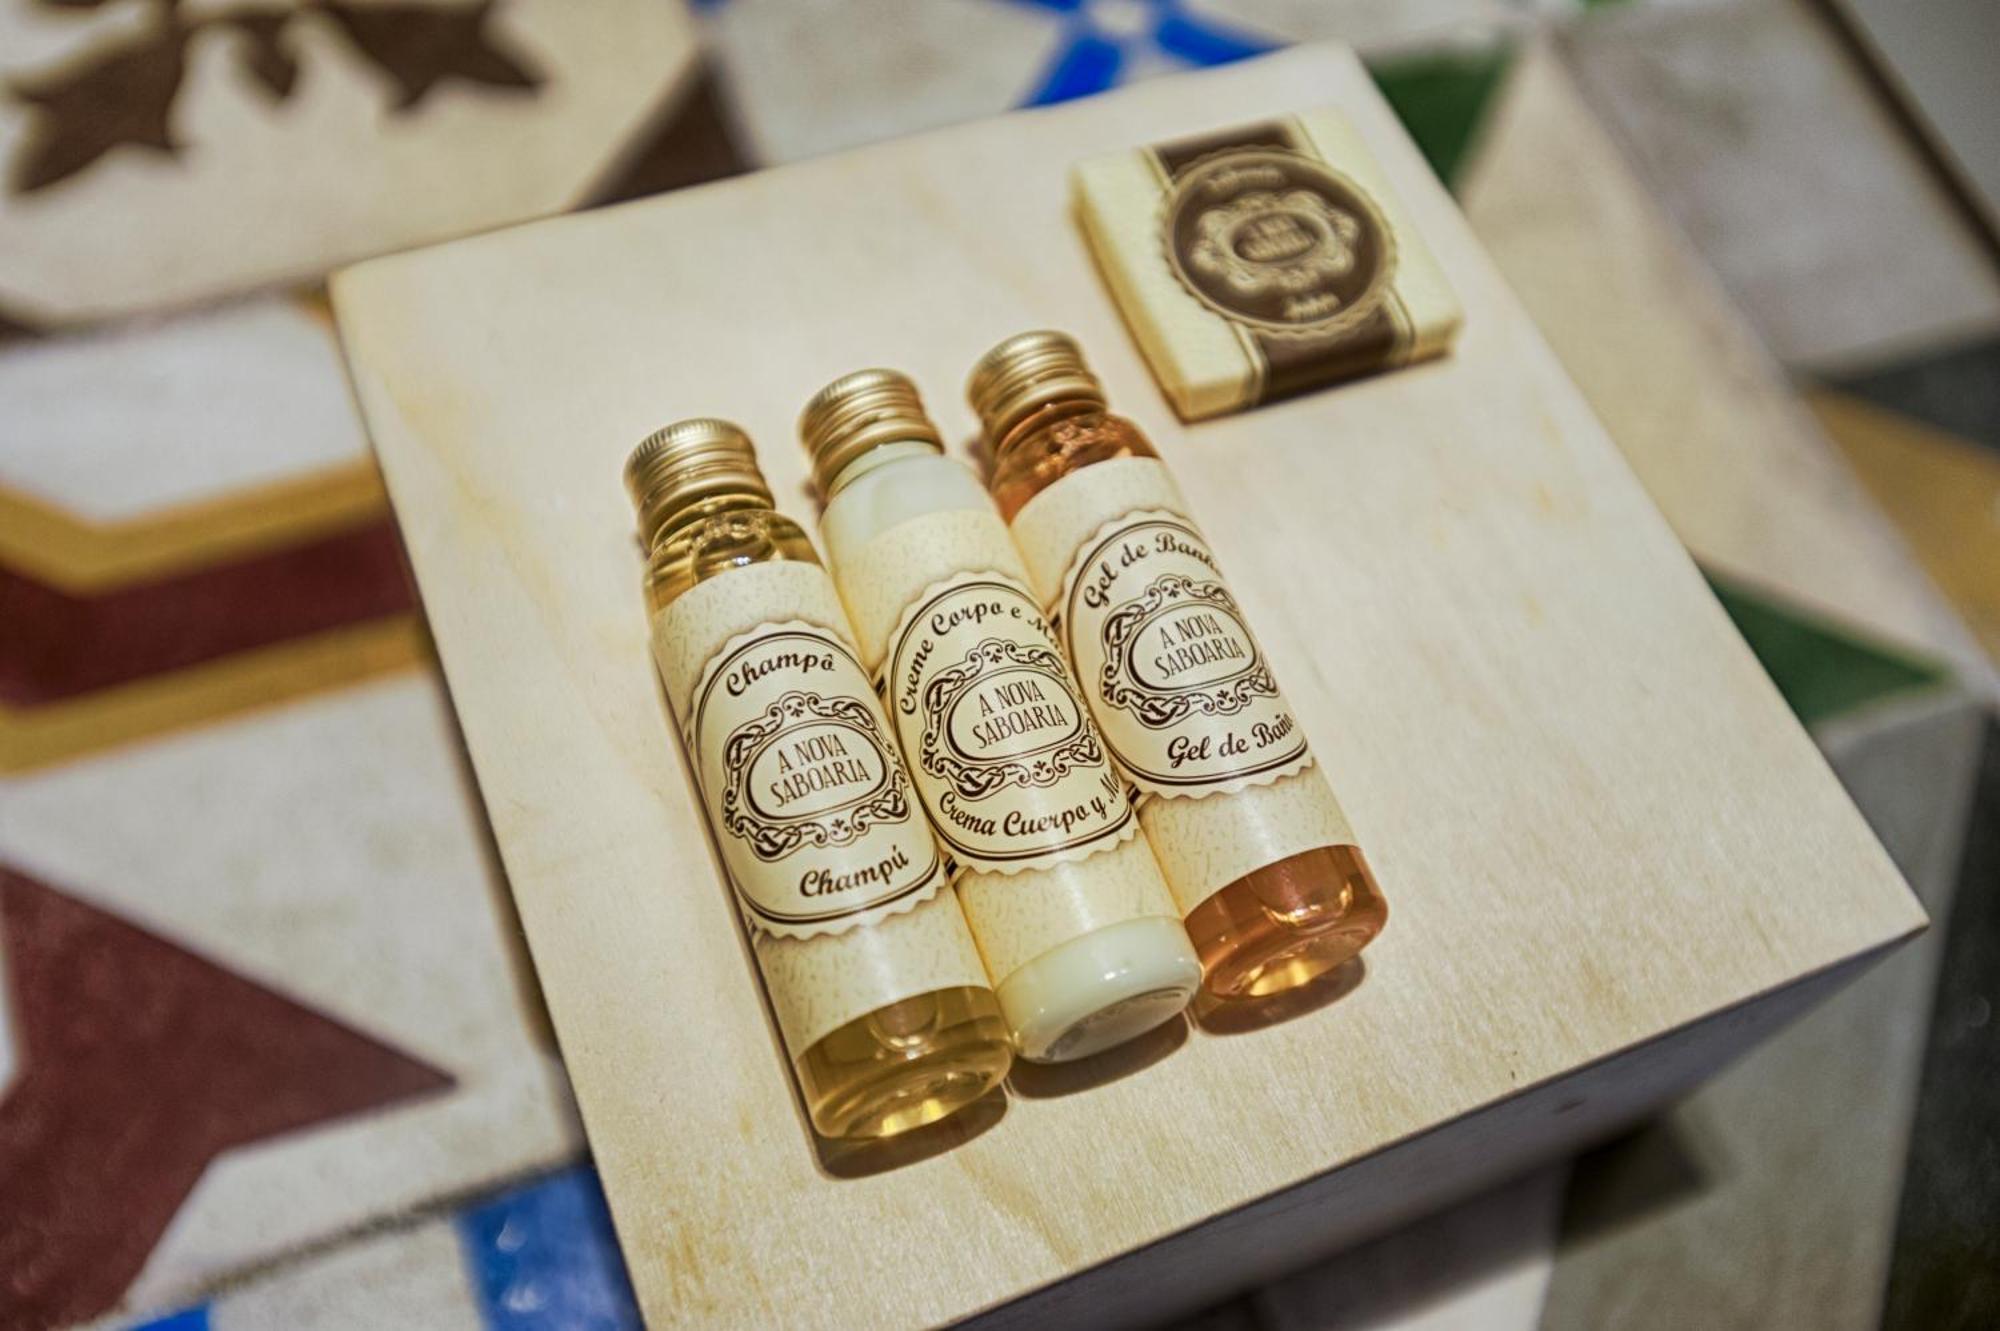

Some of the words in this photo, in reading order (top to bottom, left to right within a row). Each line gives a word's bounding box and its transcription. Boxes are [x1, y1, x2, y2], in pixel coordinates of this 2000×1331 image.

[1084, 562, 1119, 610] Gel
[1120, 543, 1149, 568] de
[1159, 627, 1175, 650] A
[1175, 613, 1223, 641] NOVA
[900, 639, 935, 716] Creme
[930, 602, 1005, 637] Corpo
[1154, 636, 1246, 680] SABOARIA
[978, 694, 994, 717] A
[996, 679, 1047, 708] NOVA
[972, 703, 1069, 750] SABOARIA
[778, 748, 792, 774] A
[794, 733, 848, 767] NOVA
[1167, 735, 1212, 769] Gel
[1218, 732, 1250, 758] de
[769, 758, 872, 808] SABOARIA
[939, 791, 997, 837] Crema
[1003, 810, 1089, 838] Cuerpo
[1090, 796, 1108, 820] y
[799, 844, 910, 897] Champú
